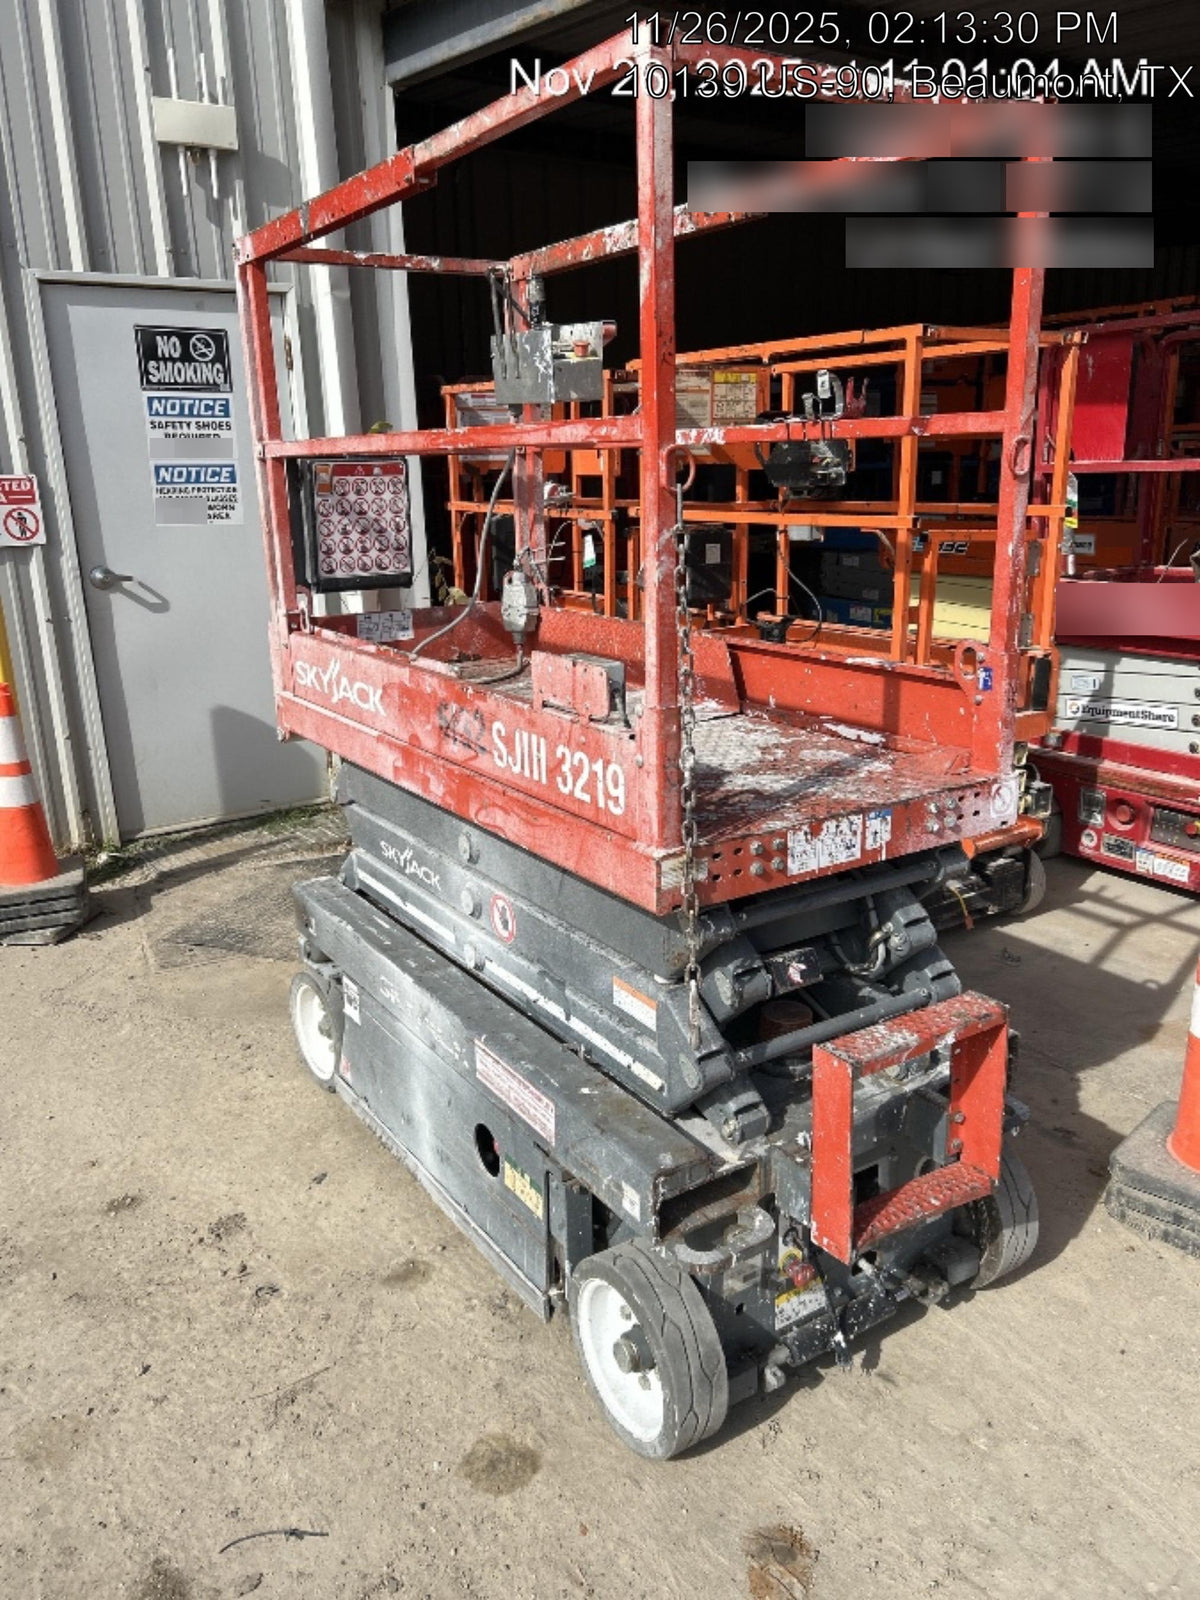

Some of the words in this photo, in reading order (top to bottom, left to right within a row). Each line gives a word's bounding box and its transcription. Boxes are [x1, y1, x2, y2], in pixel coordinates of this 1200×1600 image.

[155, 335, 182, 358] NO
[147, 360, 225, 384] SMOKING
[151, 399, 226, 416] NOTICE
[149, 420, 192, 431] SAFETY
[195, 421, 232, 431] SHOES
[158, 467, 233, 482] NOTICE
[0, 481, 31, 491] TED
[294, 656, 387, 717] SKYJACK
[1081, 704, 1176, 723] EquipmentShare
[555, 744, 626, 816] 3219
[379, 841, 442, 892] SKYJACK
